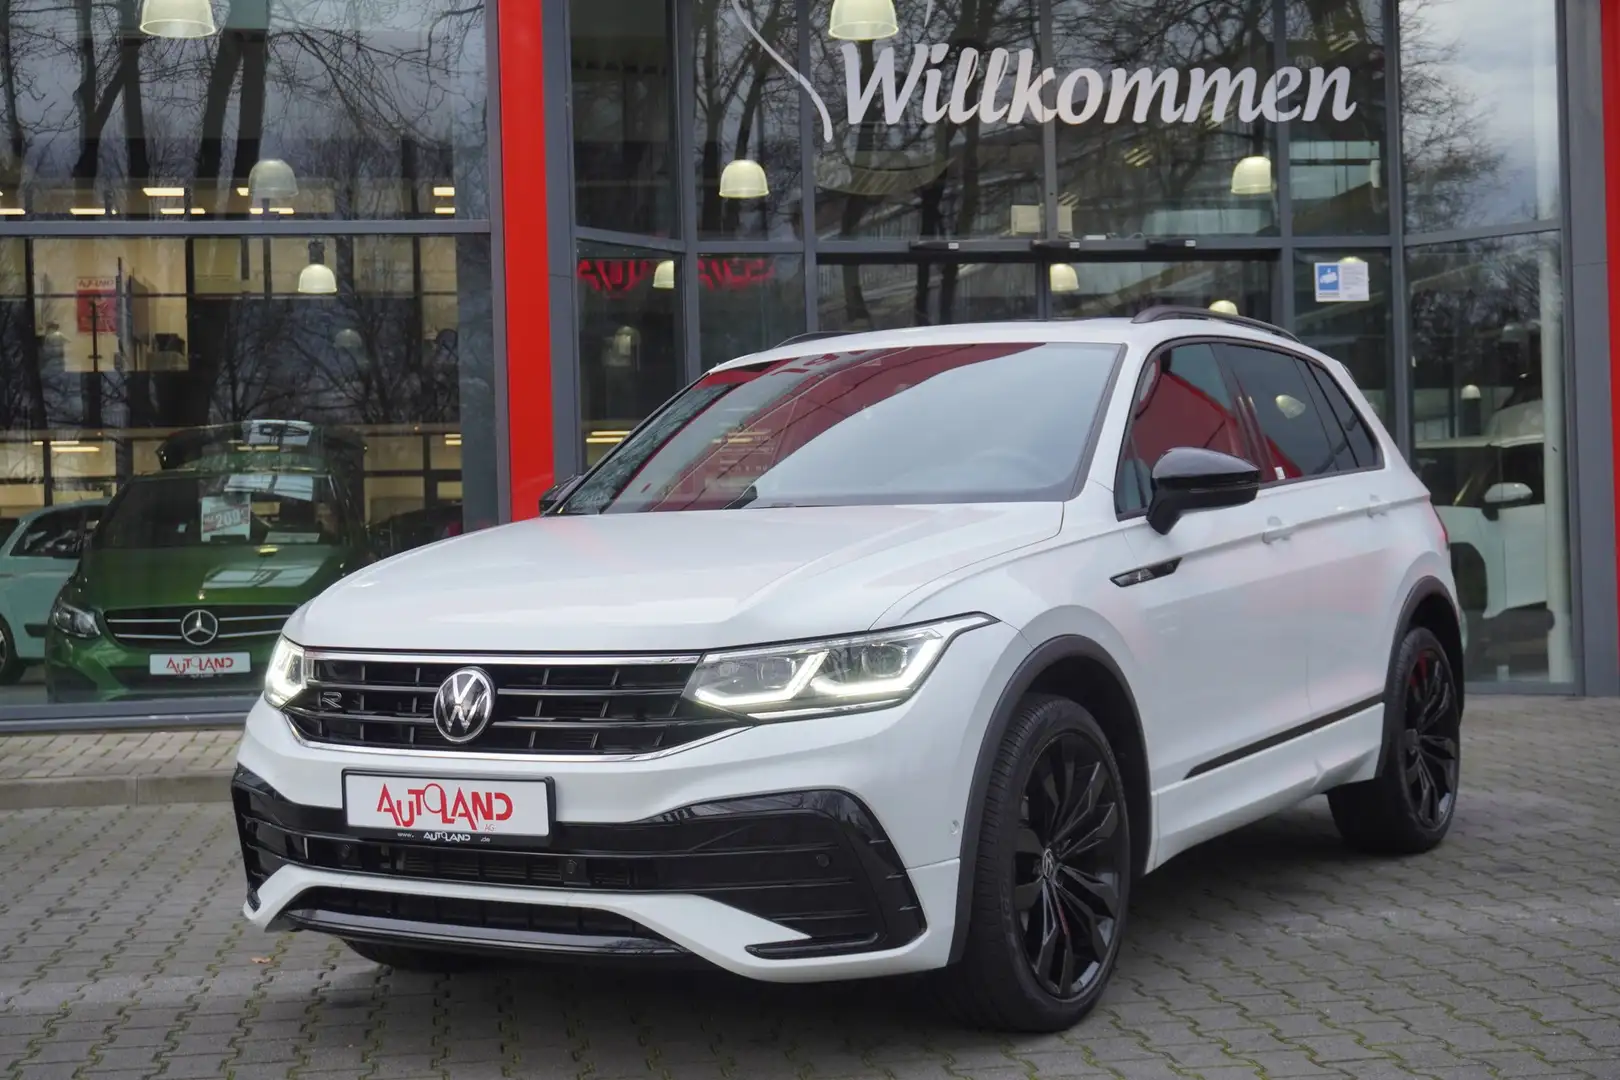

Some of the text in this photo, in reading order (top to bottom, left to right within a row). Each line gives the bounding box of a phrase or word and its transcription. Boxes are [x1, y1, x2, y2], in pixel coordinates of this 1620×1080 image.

[842, 42, 1357, 125] Willkommen
[166, 657, 234, 674] AUTOLAND
[376, 783, 513, 831] AUTOLAND
